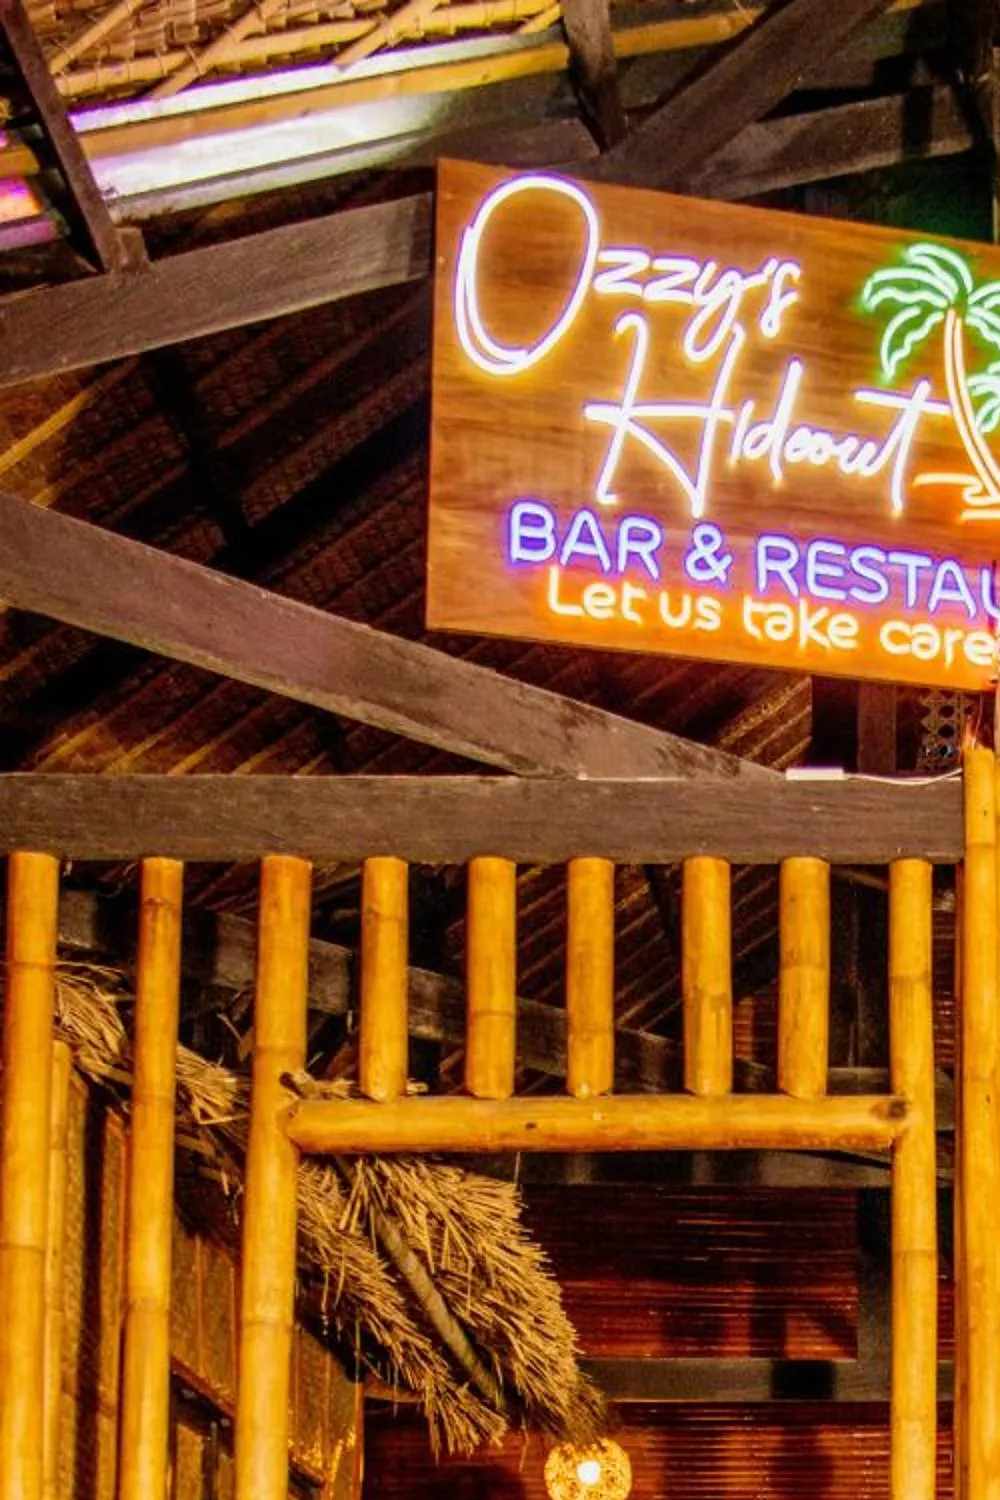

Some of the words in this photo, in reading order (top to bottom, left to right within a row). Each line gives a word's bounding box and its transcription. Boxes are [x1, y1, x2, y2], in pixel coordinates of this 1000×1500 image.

[455, 174, 801, 376] Ozzy's
[584, 311, 950, 519] Hideout
[509, 501, 662, 581] BAR
[684, 521, 734, 584] &
[547, 564, 647, 625] Let
[658, 591, 722, 631] us
[743, 594, 860, 650] take
[879, 617, 995, 669] care
